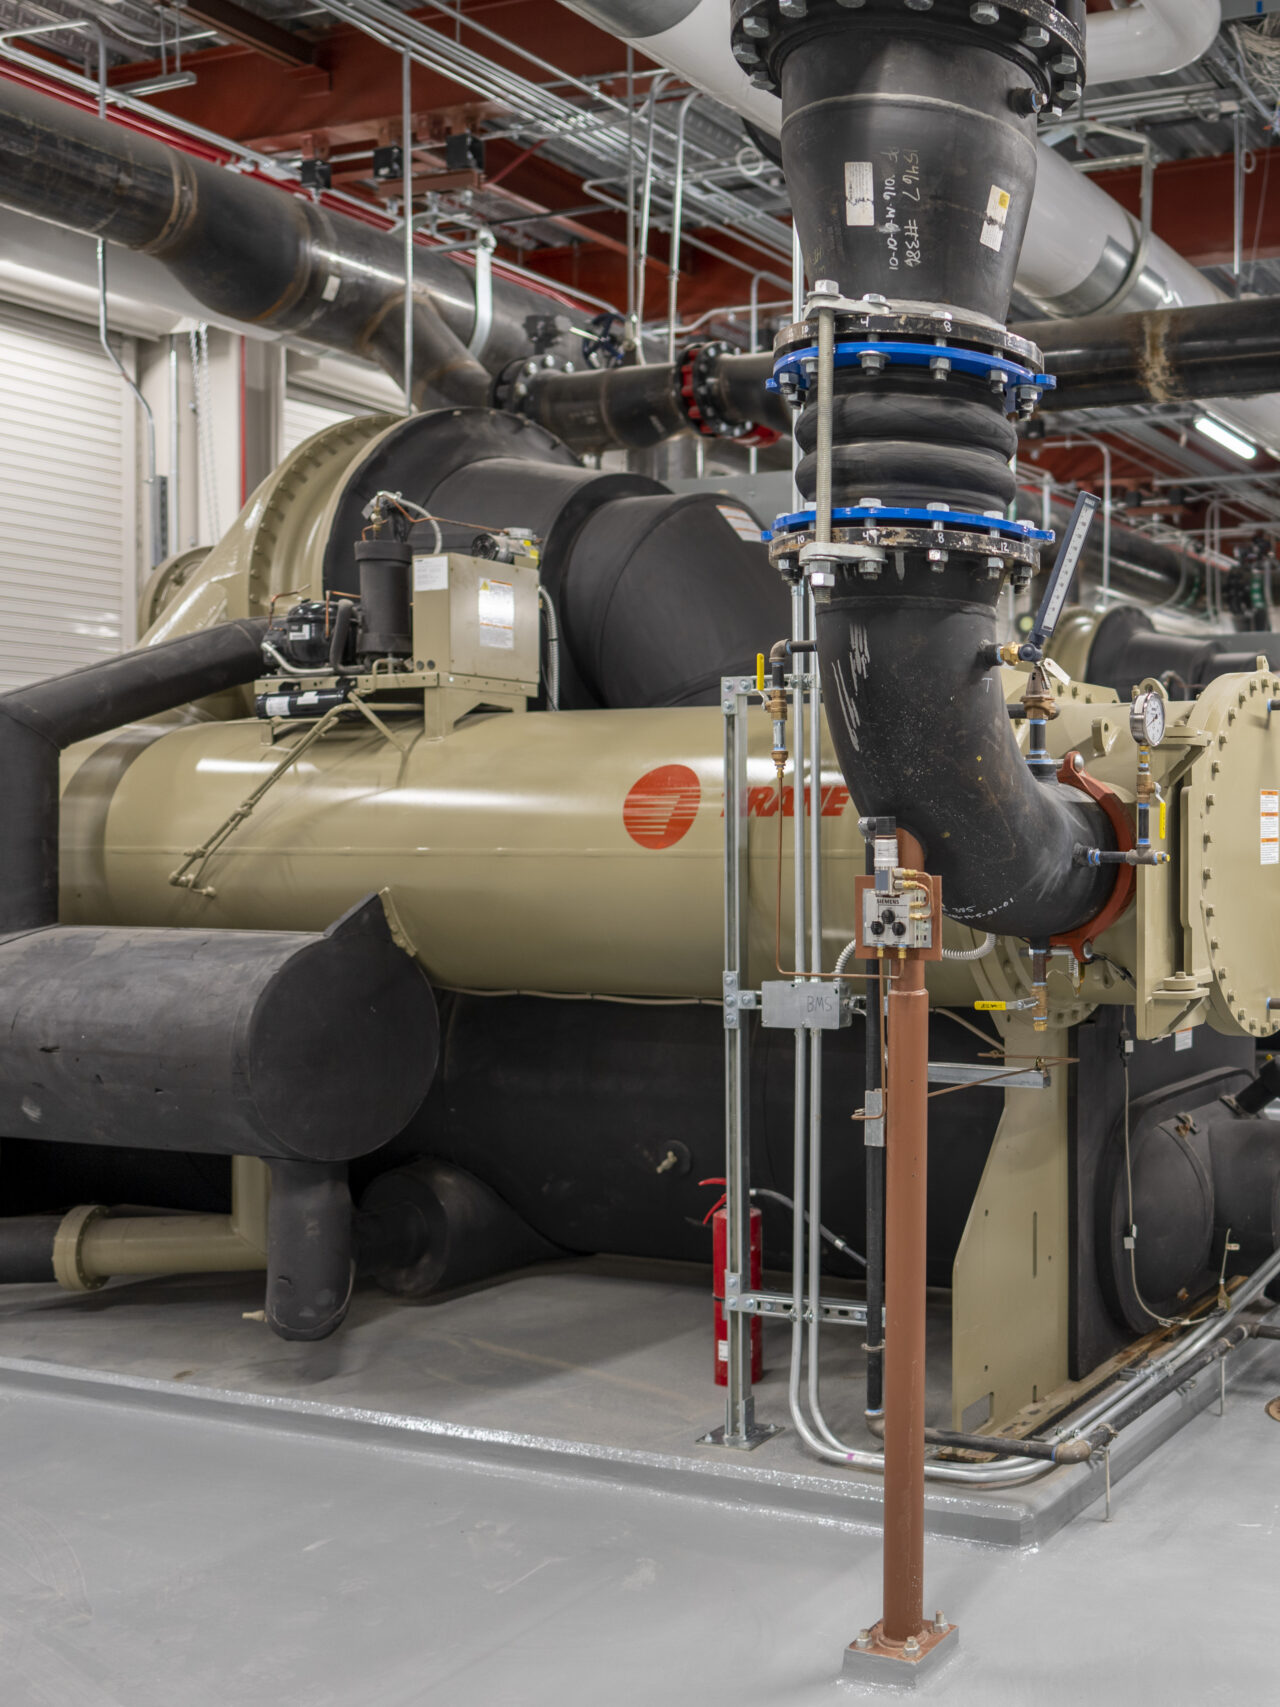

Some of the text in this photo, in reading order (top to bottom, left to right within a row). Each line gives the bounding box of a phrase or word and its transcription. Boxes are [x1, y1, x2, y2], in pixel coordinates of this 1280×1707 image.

[861, 317, 869, 327] 4
[943, 321, 952, 333] 8
[938, 532, 944, 543] 8
[1000, 542, 1010, 553] 12
[807, 995, 833, 1013] BMS
